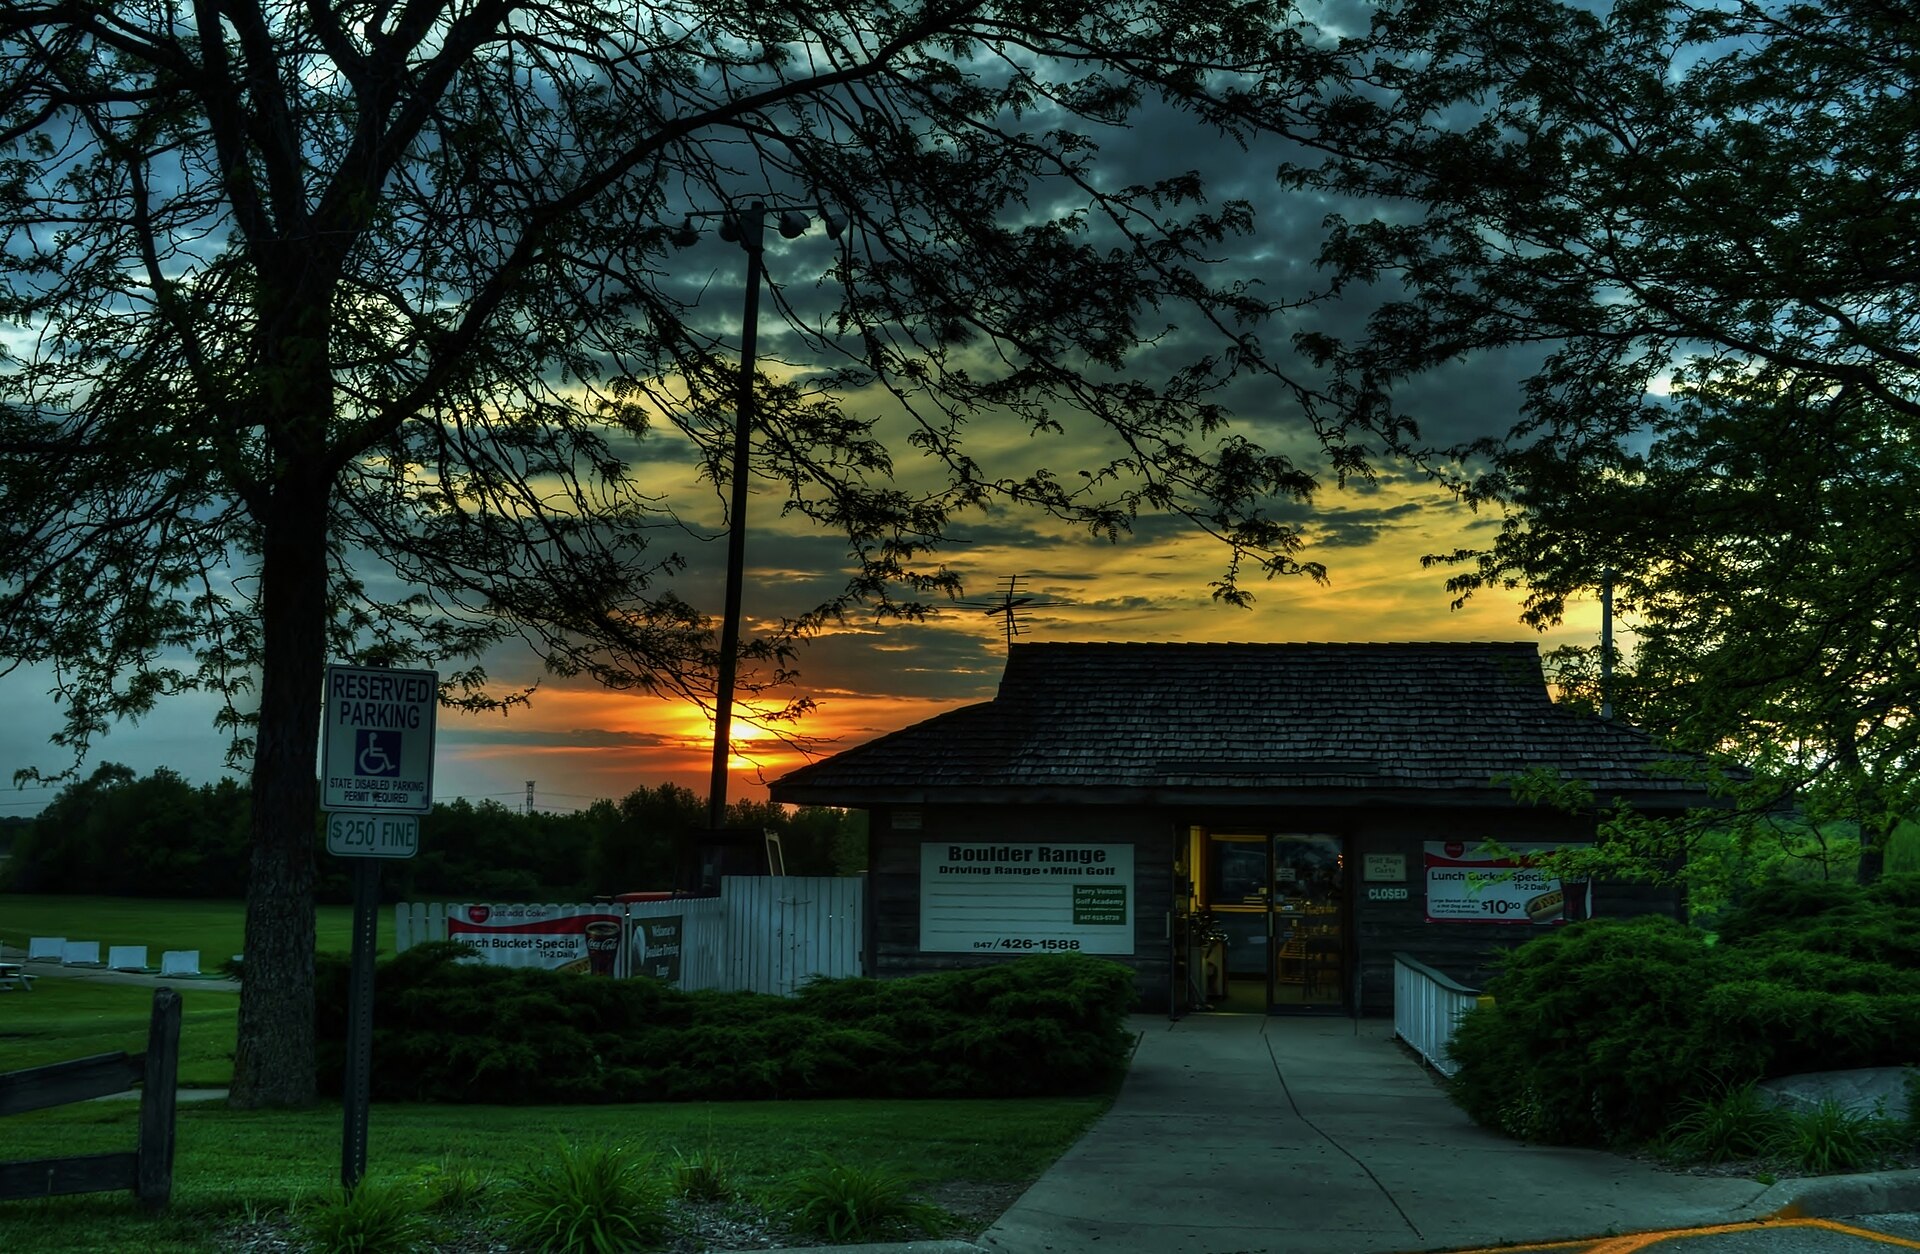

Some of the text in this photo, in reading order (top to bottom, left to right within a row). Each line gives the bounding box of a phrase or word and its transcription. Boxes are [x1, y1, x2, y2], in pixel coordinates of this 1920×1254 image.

[333, 674, 430, 703] RESERVED
[340, 701, 420, 729] PARKING
[330, 777, 424, 792] STATE DISABLED PARKING
[344, 790, 409, 803] PERMIT REQUIRED
[382, 821, 414, 847] FINE
[948, 846, 1106, 864] Boulder Range
[939, 865, 1115, 876] Driving Range Mini Golf
[1431, 871, 1549, 883] Lunch Buck Specia
[1076, 887, 1096, 896] Larry
[1514, 883, 1551, 891] 11-2 Daily
[1368, 888, 1408, 900] CLOSED
[1075, 897, 1125, 906] Golf Academy
[507, 909, 524, 917] add
[525, 909, 547, 917] Coke
[454, 937, 579, 950] unch Bucket Special
[540, 951, 579, 959] 11-2 Daily
